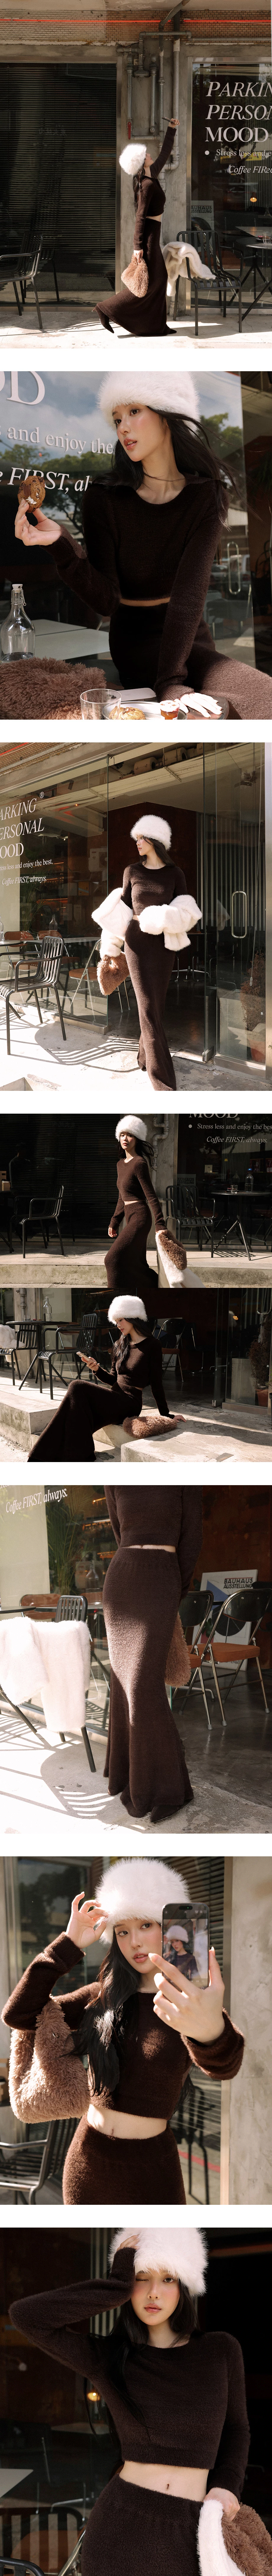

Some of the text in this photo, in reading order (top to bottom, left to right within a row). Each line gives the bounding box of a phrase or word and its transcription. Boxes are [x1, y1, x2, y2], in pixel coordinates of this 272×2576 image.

[205, 127, 268, 142] MOOD
[229, 166, 251, 175] Coffee
[8, 427, 40, 443] and
[46, 433, 86, 454] enjoy
[92, 438, 113, 454] the
[0, 843, 24, 858] OOD
[6, 1488, 67, 1514] Coffee FIRST, always.
